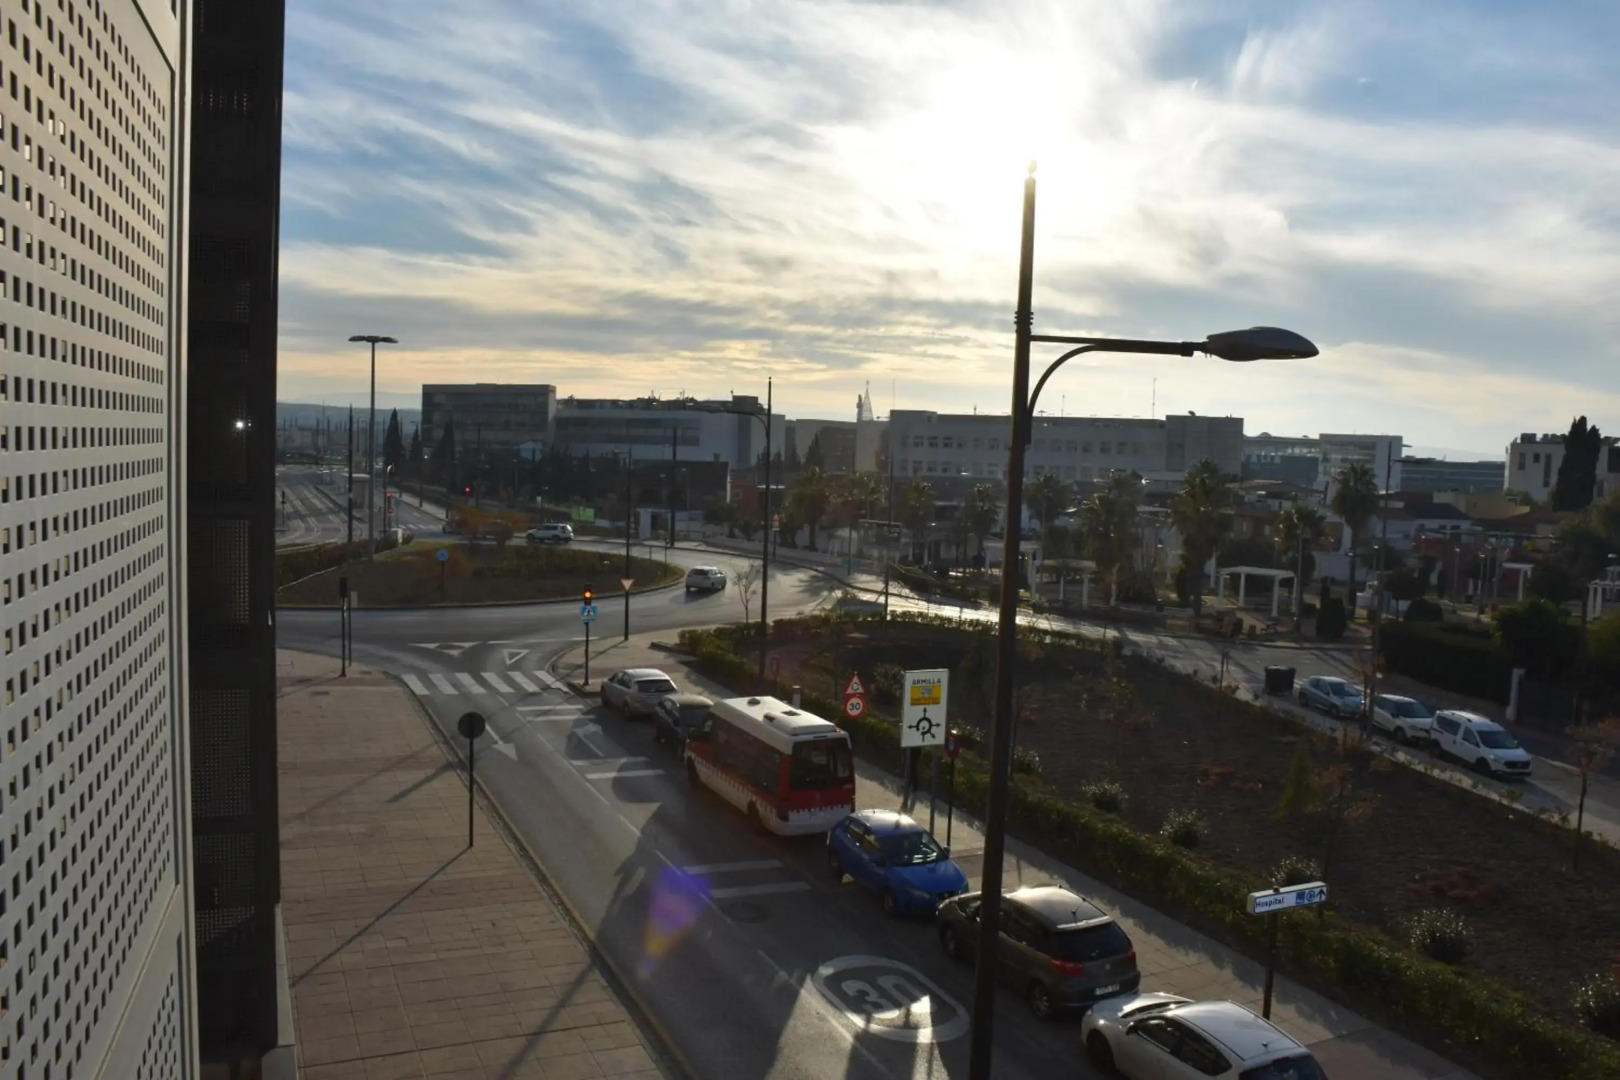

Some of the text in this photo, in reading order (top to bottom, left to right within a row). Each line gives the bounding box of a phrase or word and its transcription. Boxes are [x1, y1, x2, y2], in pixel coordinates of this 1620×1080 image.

[912, 677, 941, 685] ARMILLA
[849, 702, 861, 711] 30
[1255, 897, 1284, 909] Hospital
[841, 974, 938, 1019] 30
